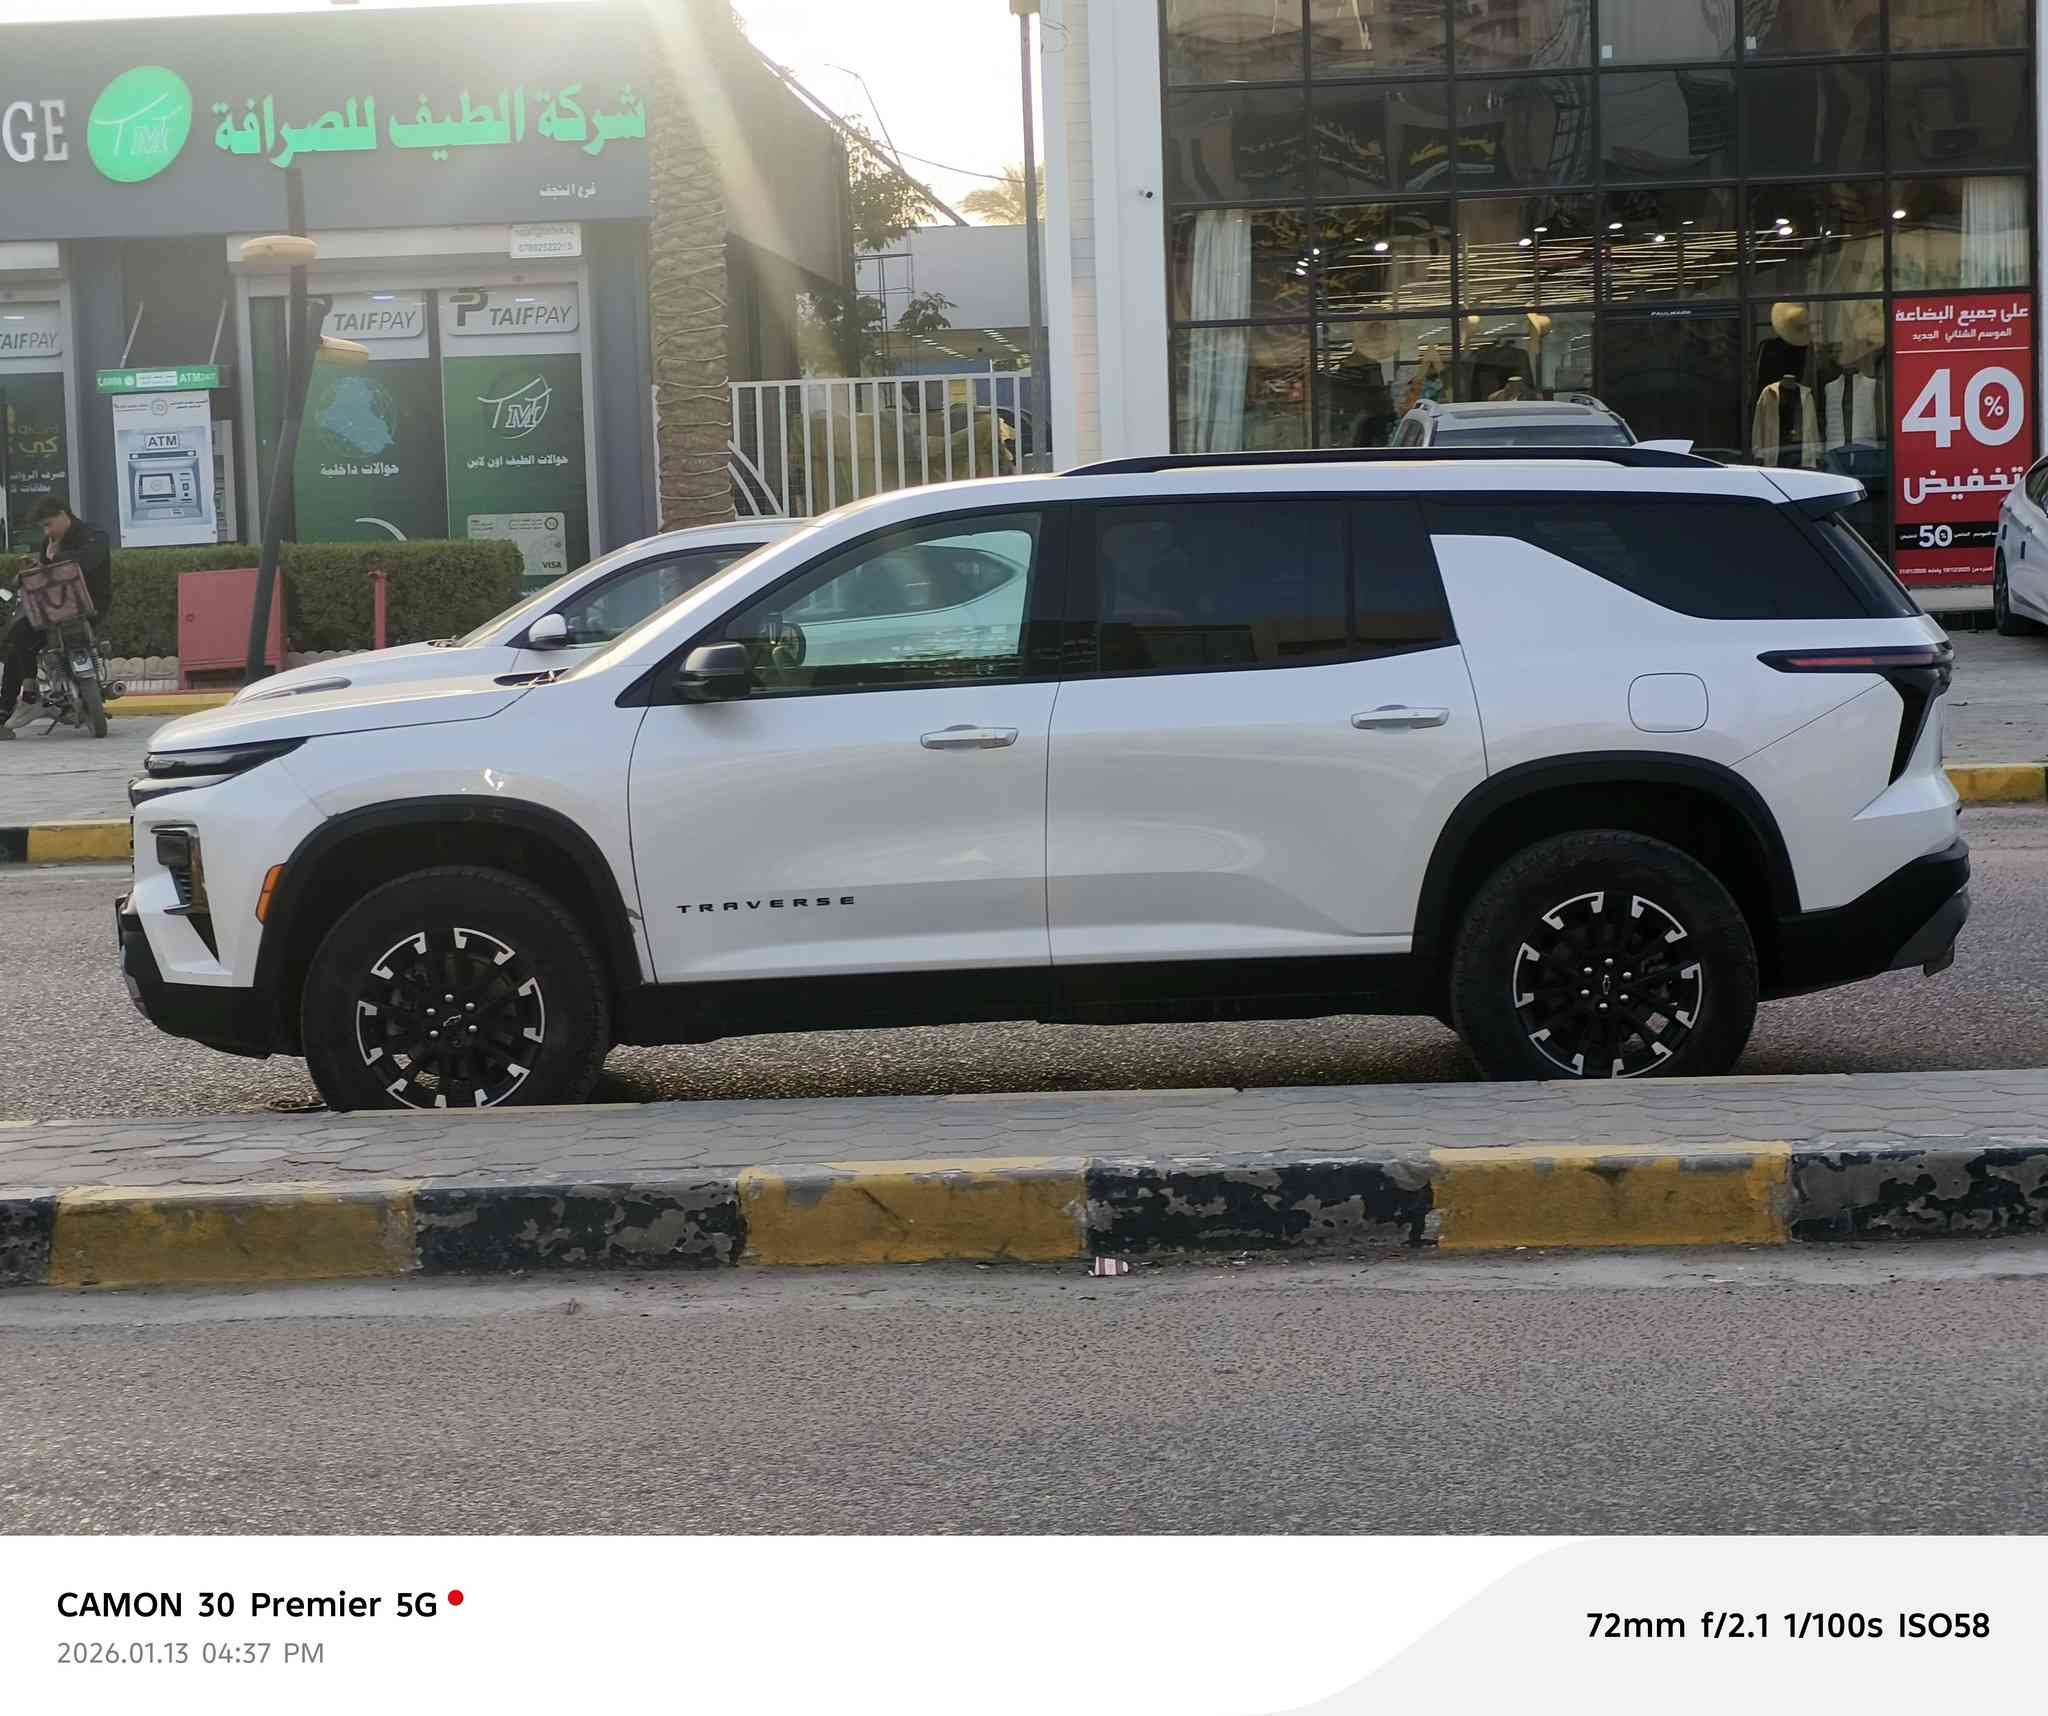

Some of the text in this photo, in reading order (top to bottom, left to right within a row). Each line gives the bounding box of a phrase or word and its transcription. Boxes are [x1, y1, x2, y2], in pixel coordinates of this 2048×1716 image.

[2, 99, 70, 163] GE
[211, 81, 646, 168] شركة الطيف للصرافة
[333, 311, 416, 331] TAIFPAY
[489, 305, 573, 326] TAIFPAY
[1957, 308, 1997, 326] جميع
[2001, 303, 2029, 323] على
[0, 331, 58, 349] AIFPAY
[147, 436, 178, 448] ATM
[537, 454, 569, 466] حوالات
[320, 462, 400, 479] حوالات داخلية
[1903, 466, 2024, 504] تخفيض
[542, 561, 562, 569] VISA
[676, 895, 855, 914] TRAVERSE
